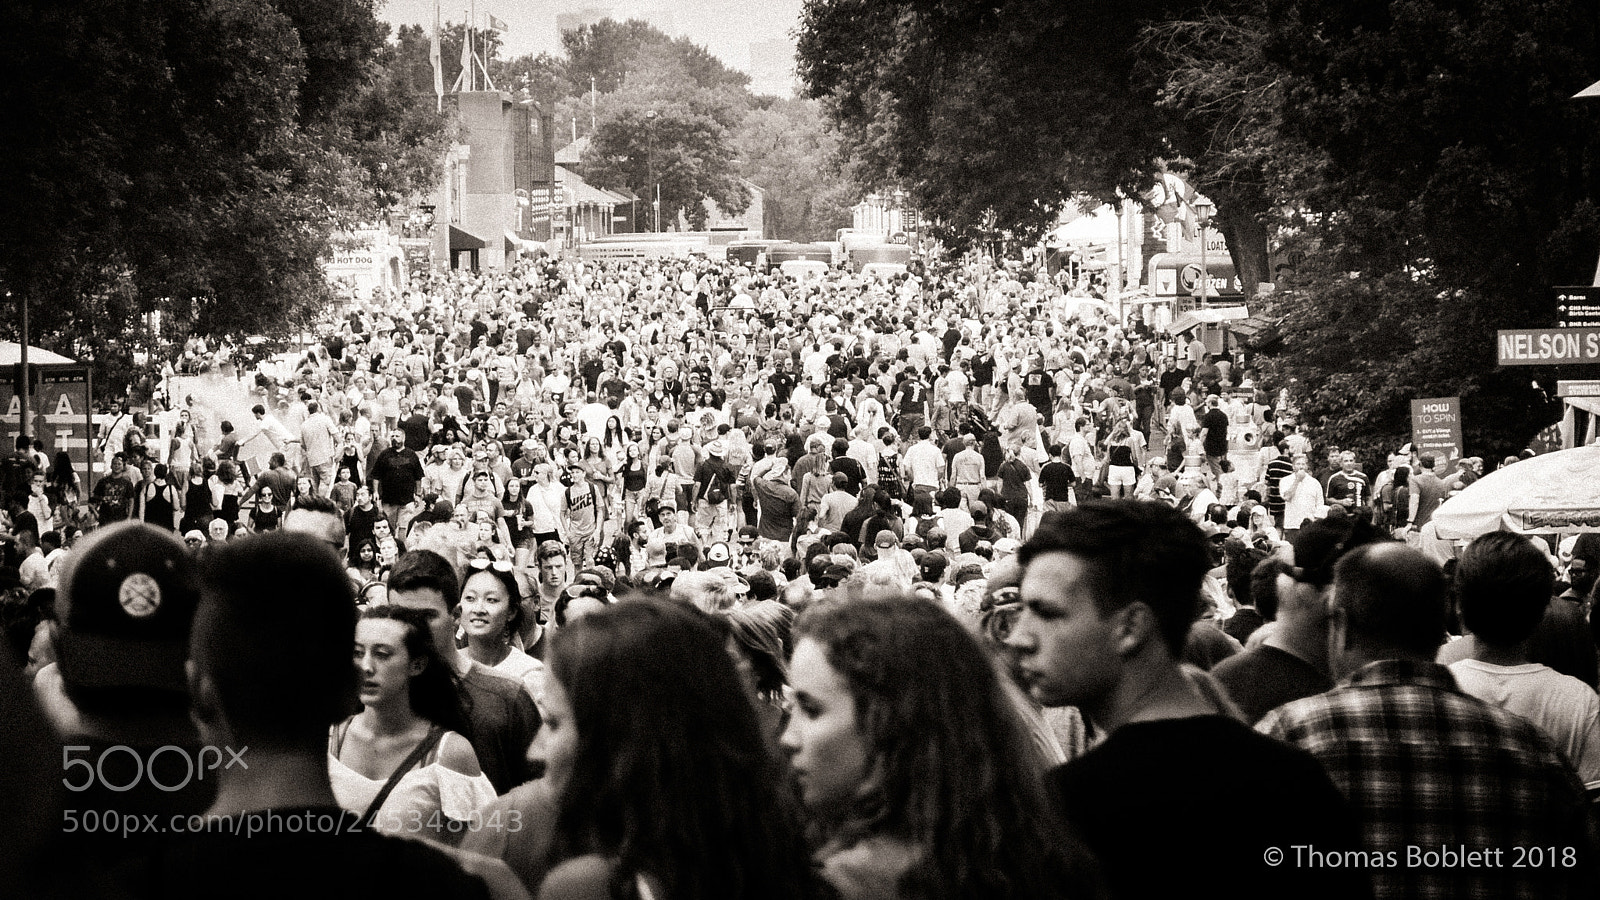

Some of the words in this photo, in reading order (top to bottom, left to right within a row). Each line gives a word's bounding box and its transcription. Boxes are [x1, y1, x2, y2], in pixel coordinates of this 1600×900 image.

[1500, 334, 1580, 360] NELSON
[1586, 333, 1600, 358] S
[1422, 403, 1450, 413] HOW
[1417, 415, 1432, 423] TO
[1434, 413, 1456, 423] SPIN
